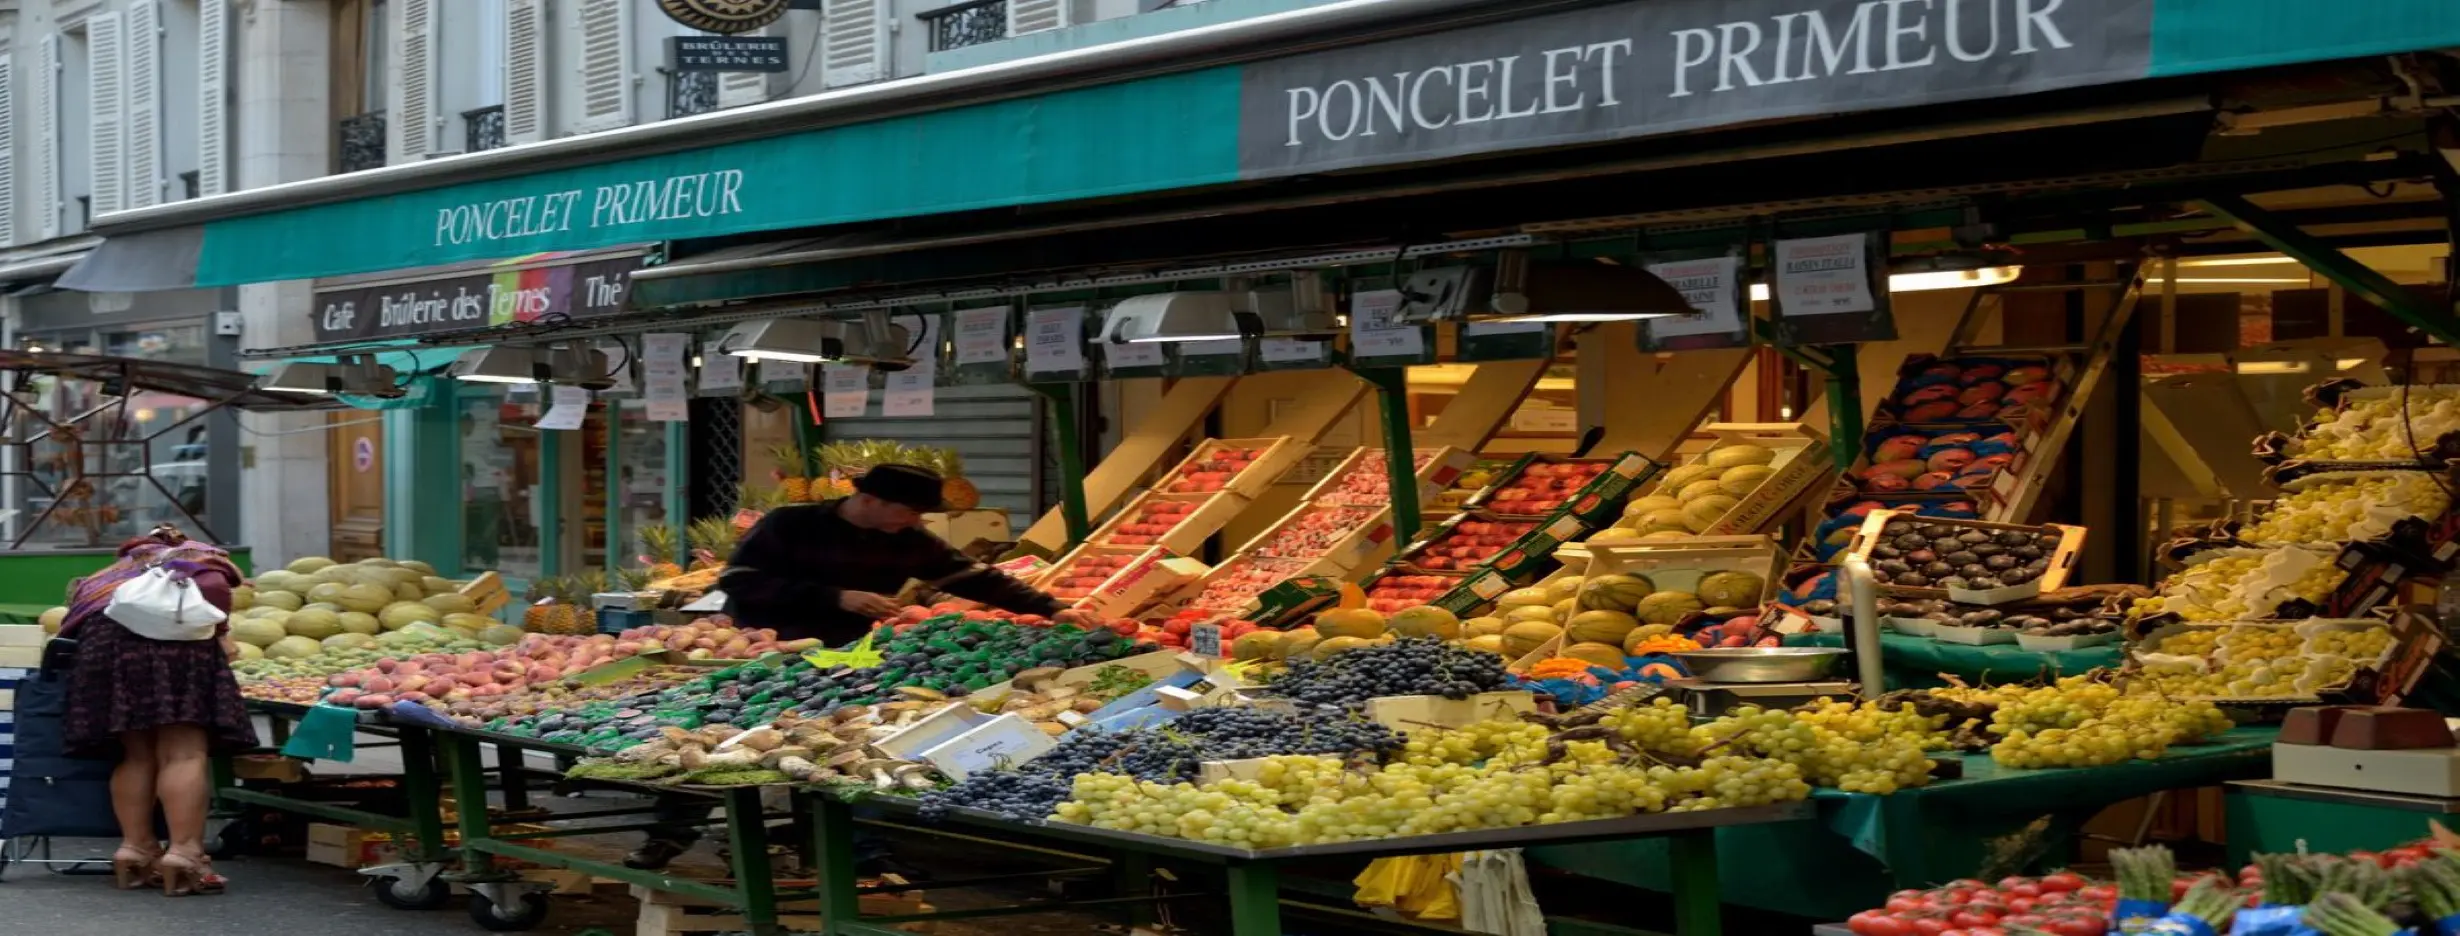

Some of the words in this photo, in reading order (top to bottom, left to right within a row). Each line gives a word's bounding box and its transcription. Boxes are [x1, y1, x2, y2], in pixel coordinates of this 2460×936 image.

[682, 40, 780, 50] BRÛLERIE
[684, 56, 781, 64] TERNES
[1284, 38, 1633, 147] PONCELET
[1668, 0, 2074, 98] PRIMEUR
[434, 190, 582, 246] PONCELET
[590, 169, 744, 228] PRIMEUR
[322, 301, 355, 330] Café
[380, 290, 447, 327] Brûlerie
[452, 286, 483, 320] des
[487, 284, 552, 316] Ternes
[586, 273, 622, 307] Thé
